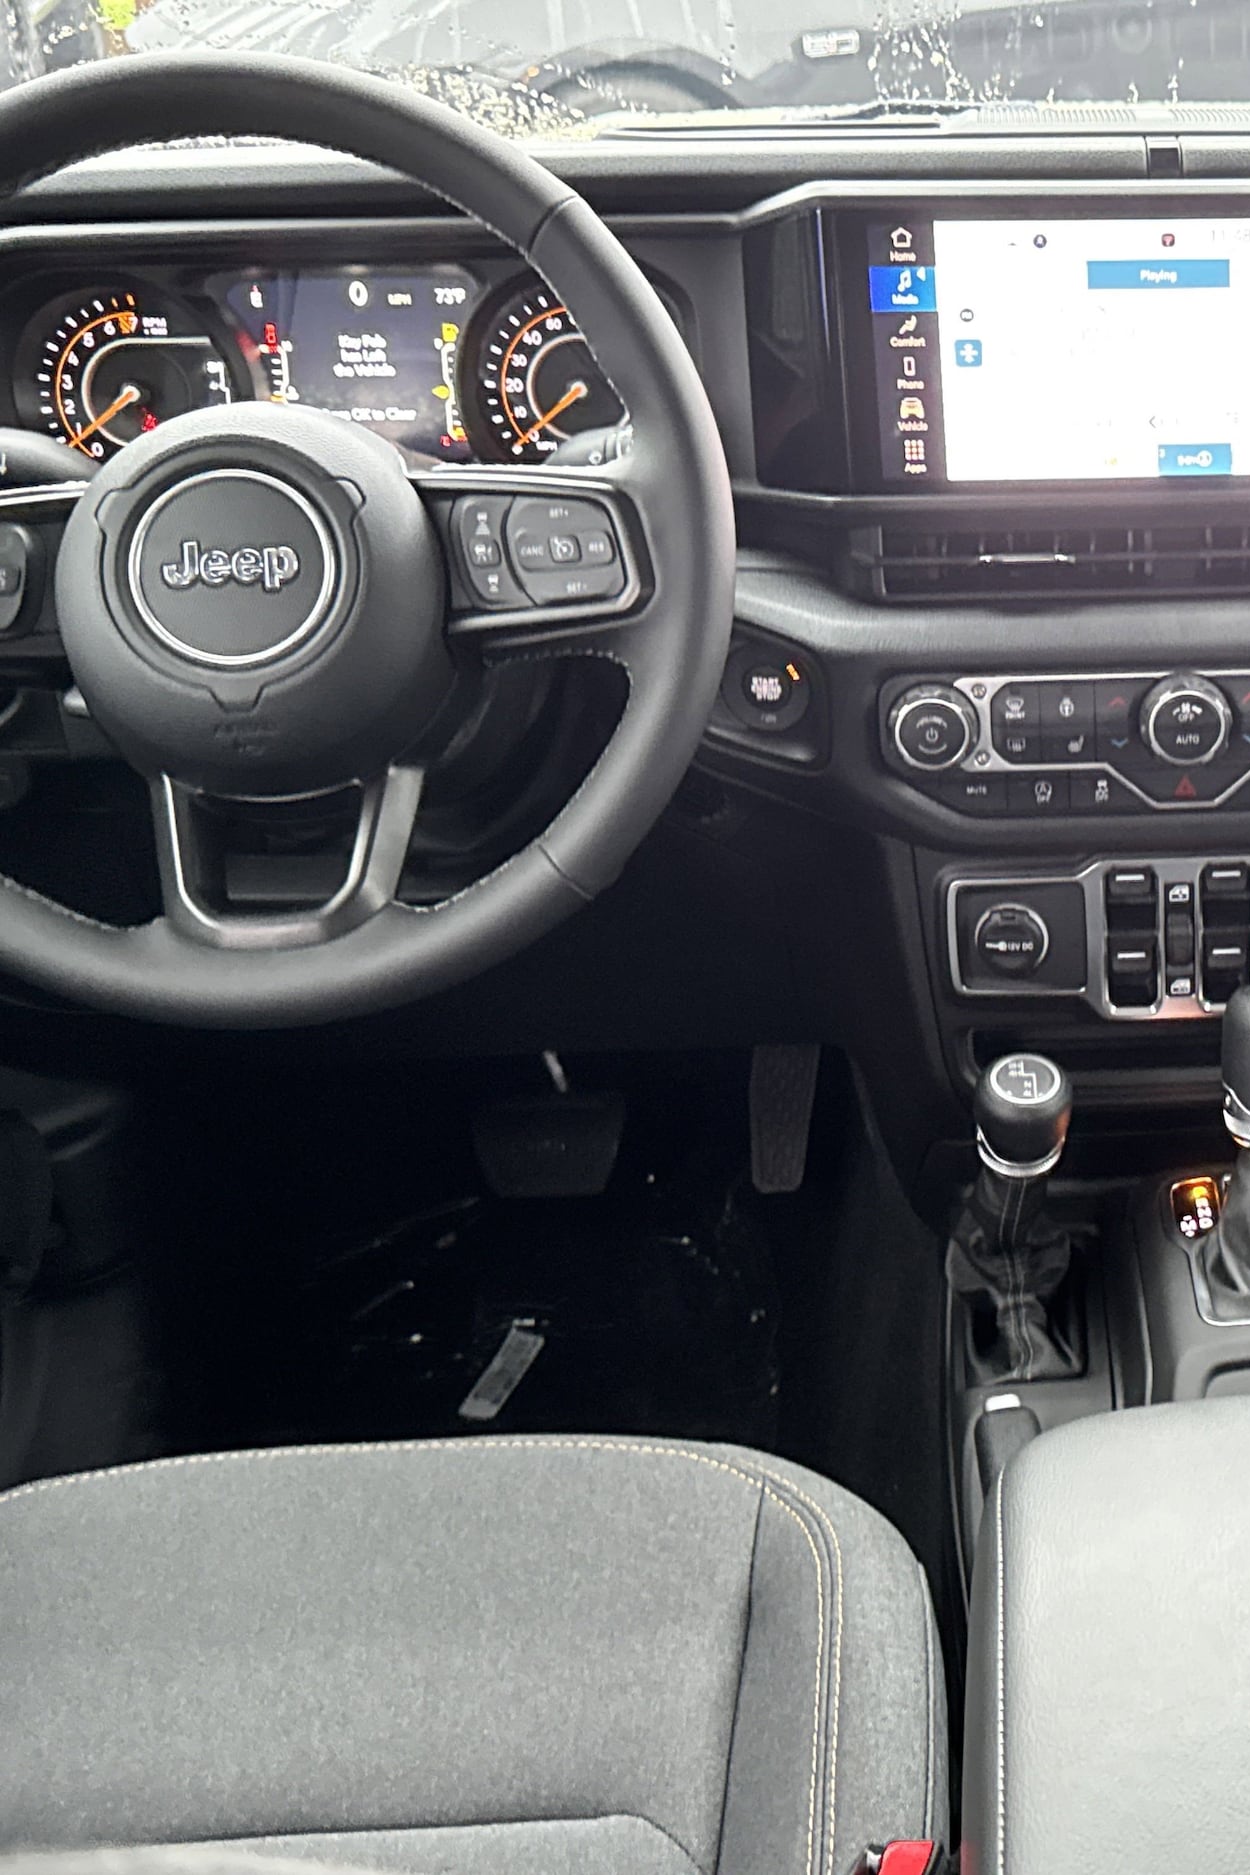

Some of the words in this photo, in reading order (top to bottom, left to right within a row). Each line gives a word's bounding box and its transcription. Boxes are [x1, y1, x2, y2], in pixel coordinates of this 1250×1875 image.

[889, 250, 917, 262] Home
[1139, 268, 1178, 283] Playing
[142, 316, 168, 328] RPM
[161, 539, 300, 593] Jeep
[1175, 732, 1200, 746] AUTO
[966, 784, 988, 796] MUTE
[1196, 1206, 1212, 1218] N
